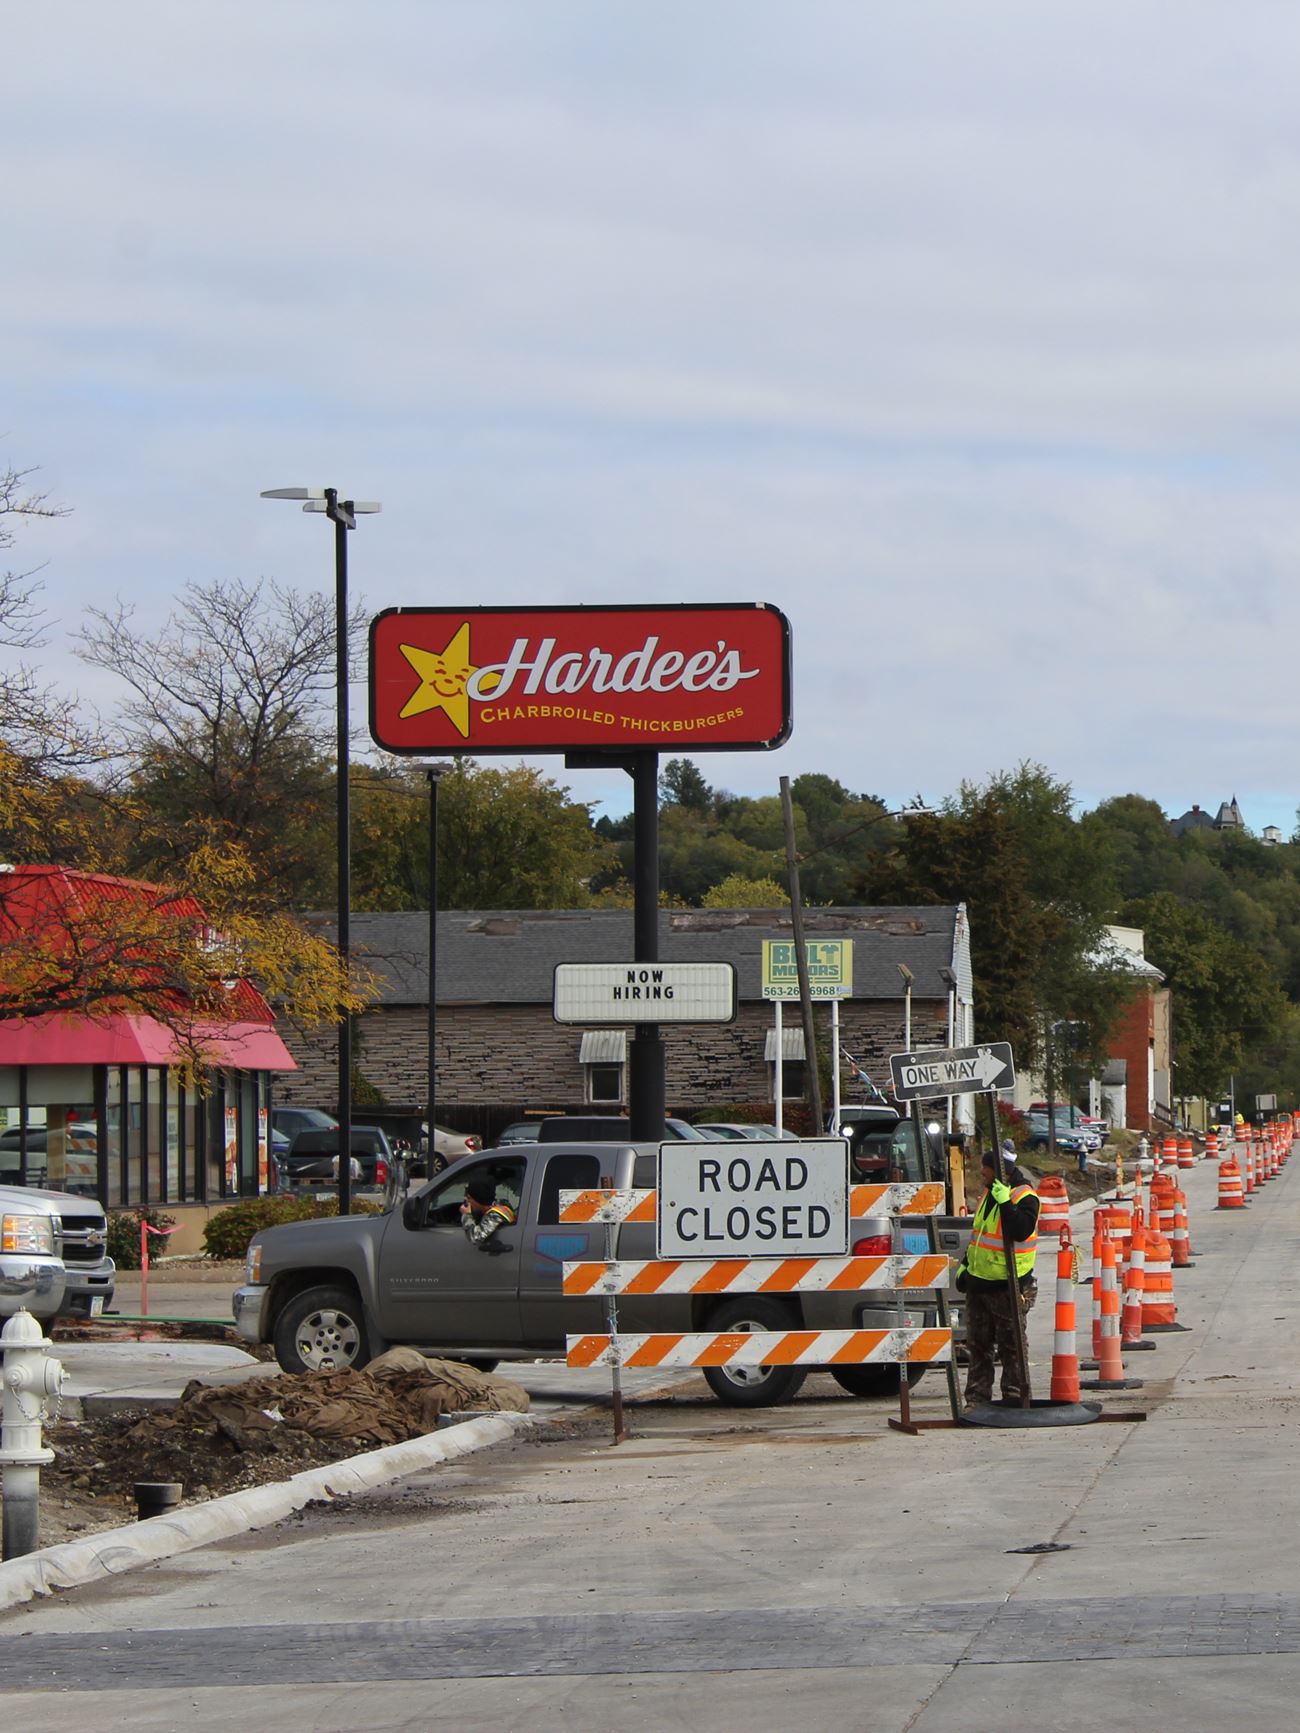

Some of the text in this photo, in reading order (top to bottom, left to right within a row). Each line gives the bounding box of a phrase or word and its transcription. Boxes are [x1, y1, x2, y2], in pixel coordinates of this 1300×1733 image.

[465, 636, 760, 702] Hardee's
[480, 705, 745, 732] CHARBROILED THICKBURGERS
[627, 970, 663, 983] NOW
[772, 965, 839, 976] MOORS
[613, 986, 673, 999] HIRING
[763, 986, 836, 996] 563-266968
[906, 1060, 977, 1085] ONE WAY
[699, 1158, 808, 1192] ROAD
[676, 1205, 831, 1241] CLOSED
